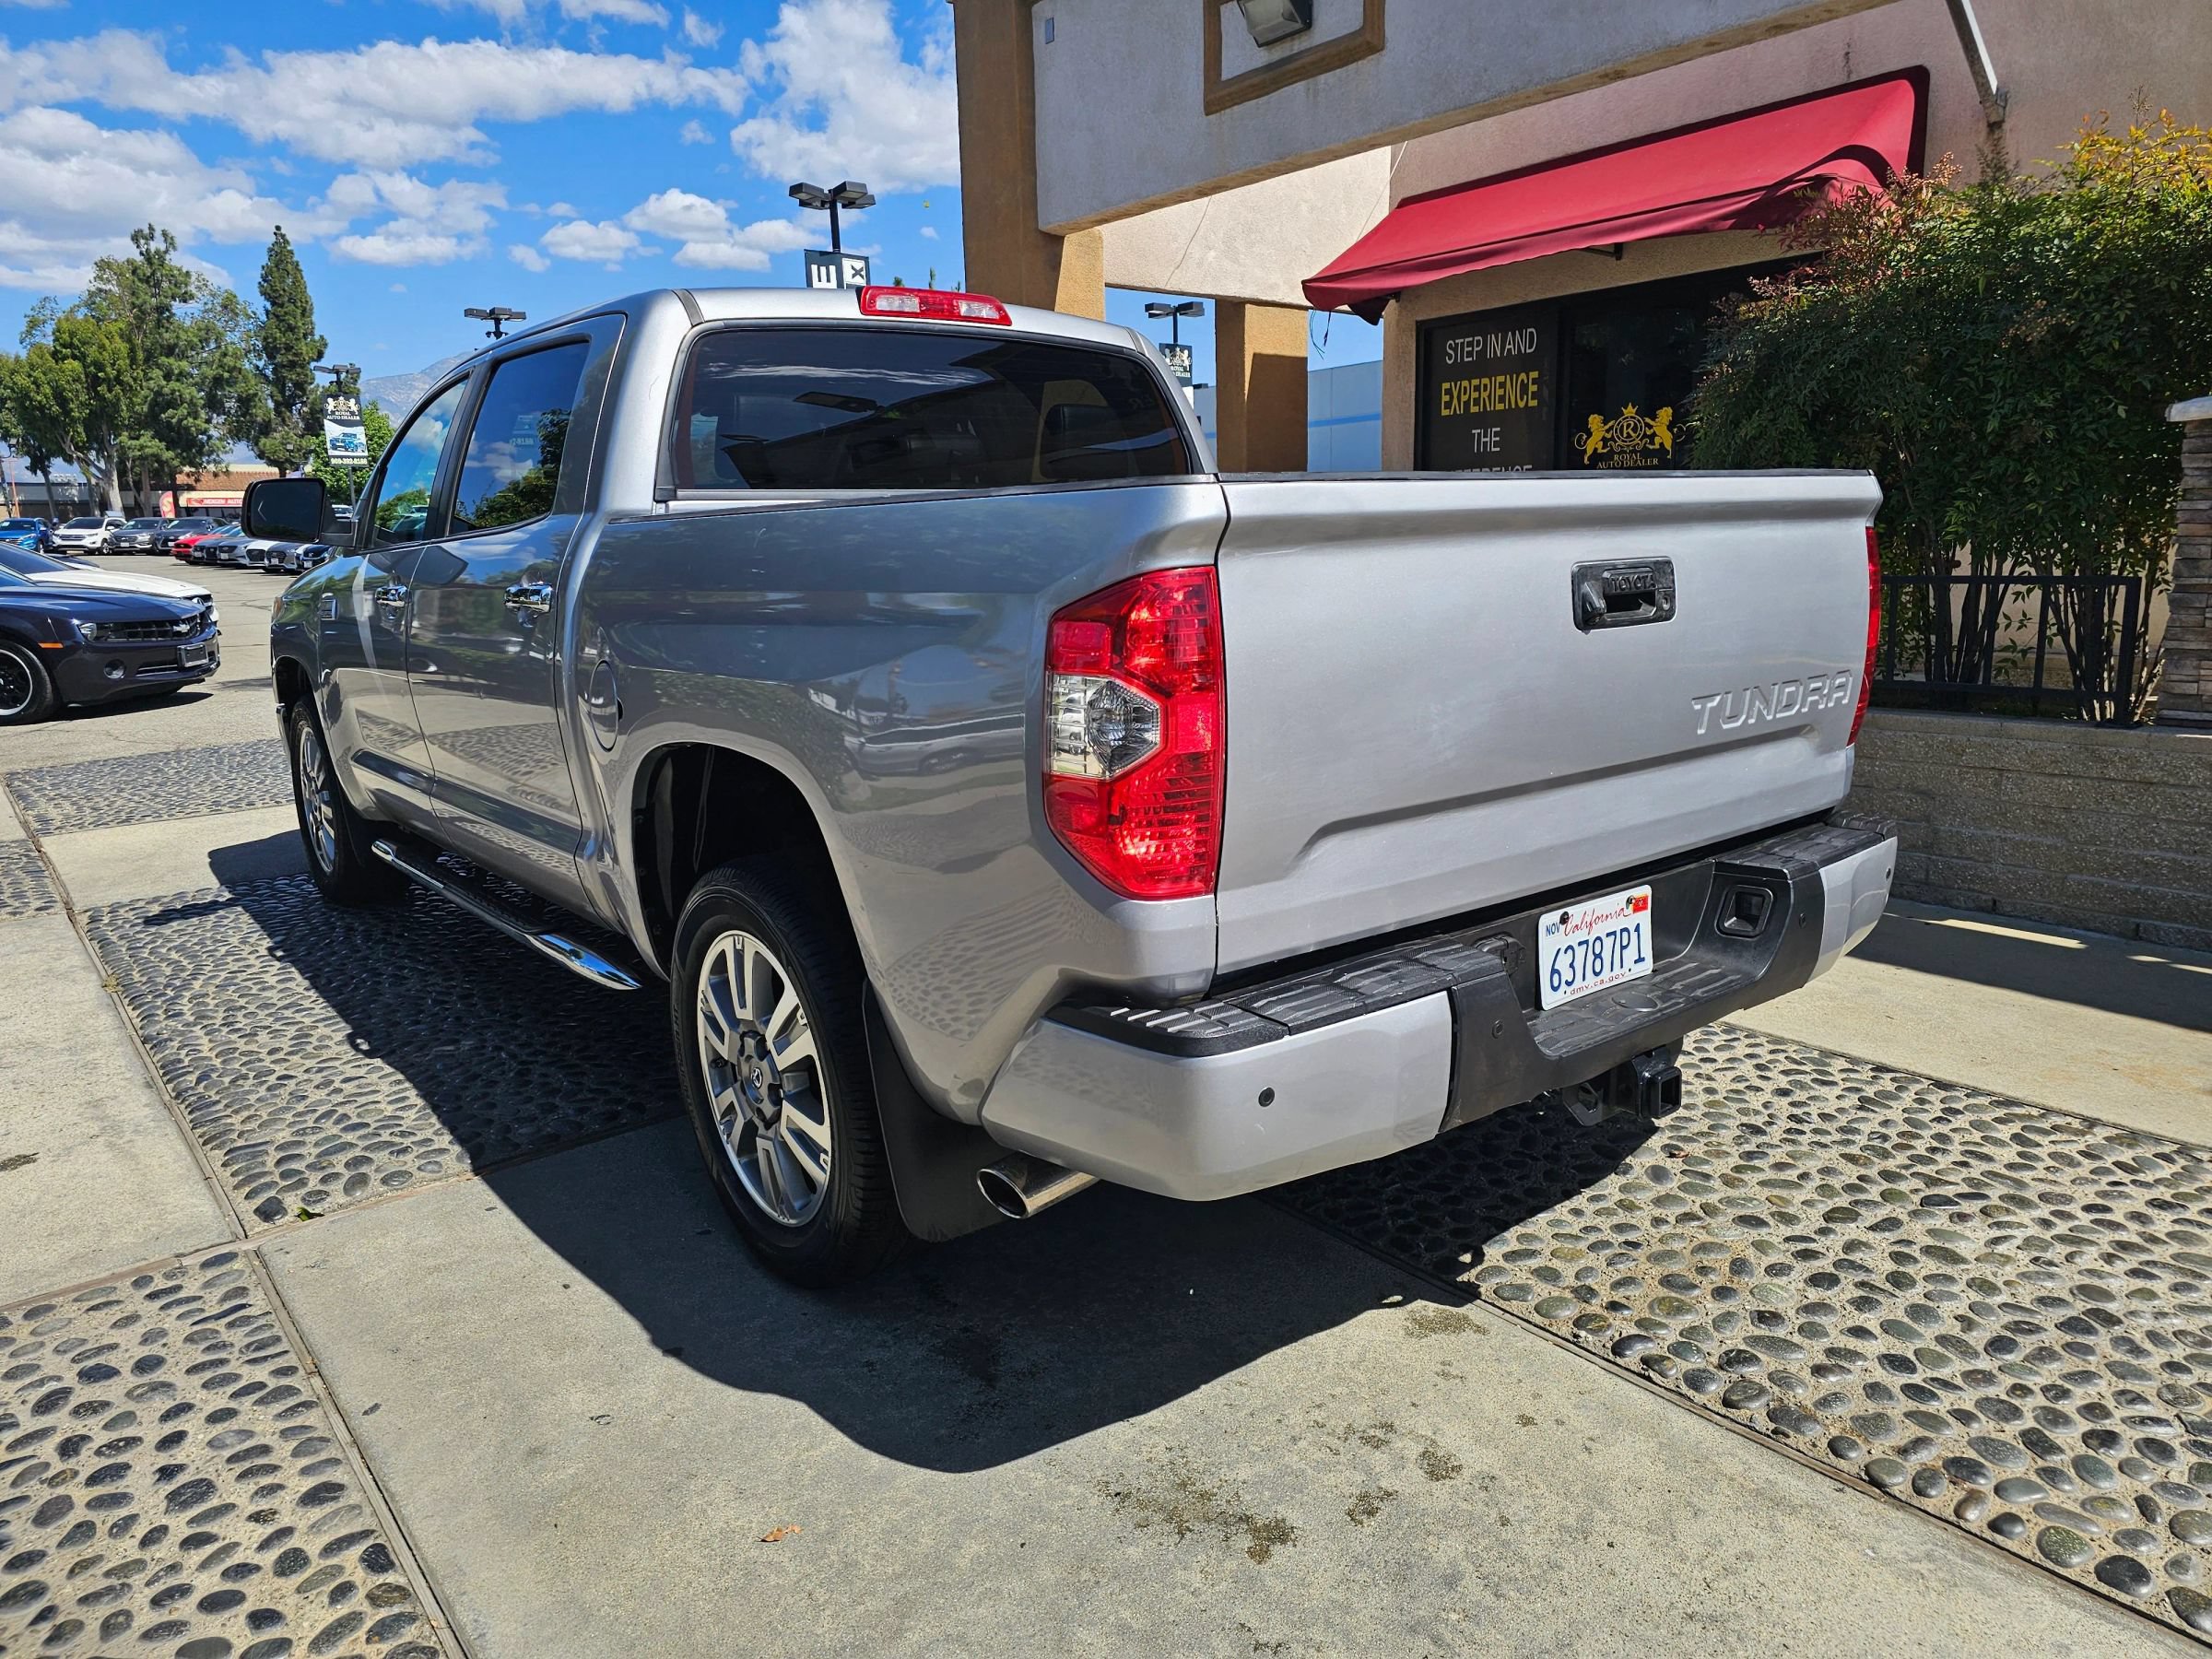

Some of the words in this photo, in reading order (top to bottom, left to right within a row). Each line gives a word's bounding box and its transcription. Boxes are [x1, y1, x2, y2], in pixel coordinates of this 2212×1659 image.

[1445, 335, 1483, 364] STEP
[1487, 333, 1501, 359] IN
[1504, 327, 1537, 357] AND
[1441, 371, 1539, 417] EXPERIENCE
[1472, 428, 1500, 453] THE
[1623, 420, 1637, 439] R
[1597, 460, 1621, 469] AUTO
[1623, 458, 1659, 467] DEALER
[1614, 452, 1642, 462] ROYAL
[1610, 573, 1657, 591] TOYOTA
[1691, 669, 1853, 735] TUNDRA
[1546, 922, 1560, 937] NOV
[1563, 904, 1631, 936] California
[1550, 924, 1645, 992] 63787P1
[1570, 971, 1627, 995] dmv.ca.gov
